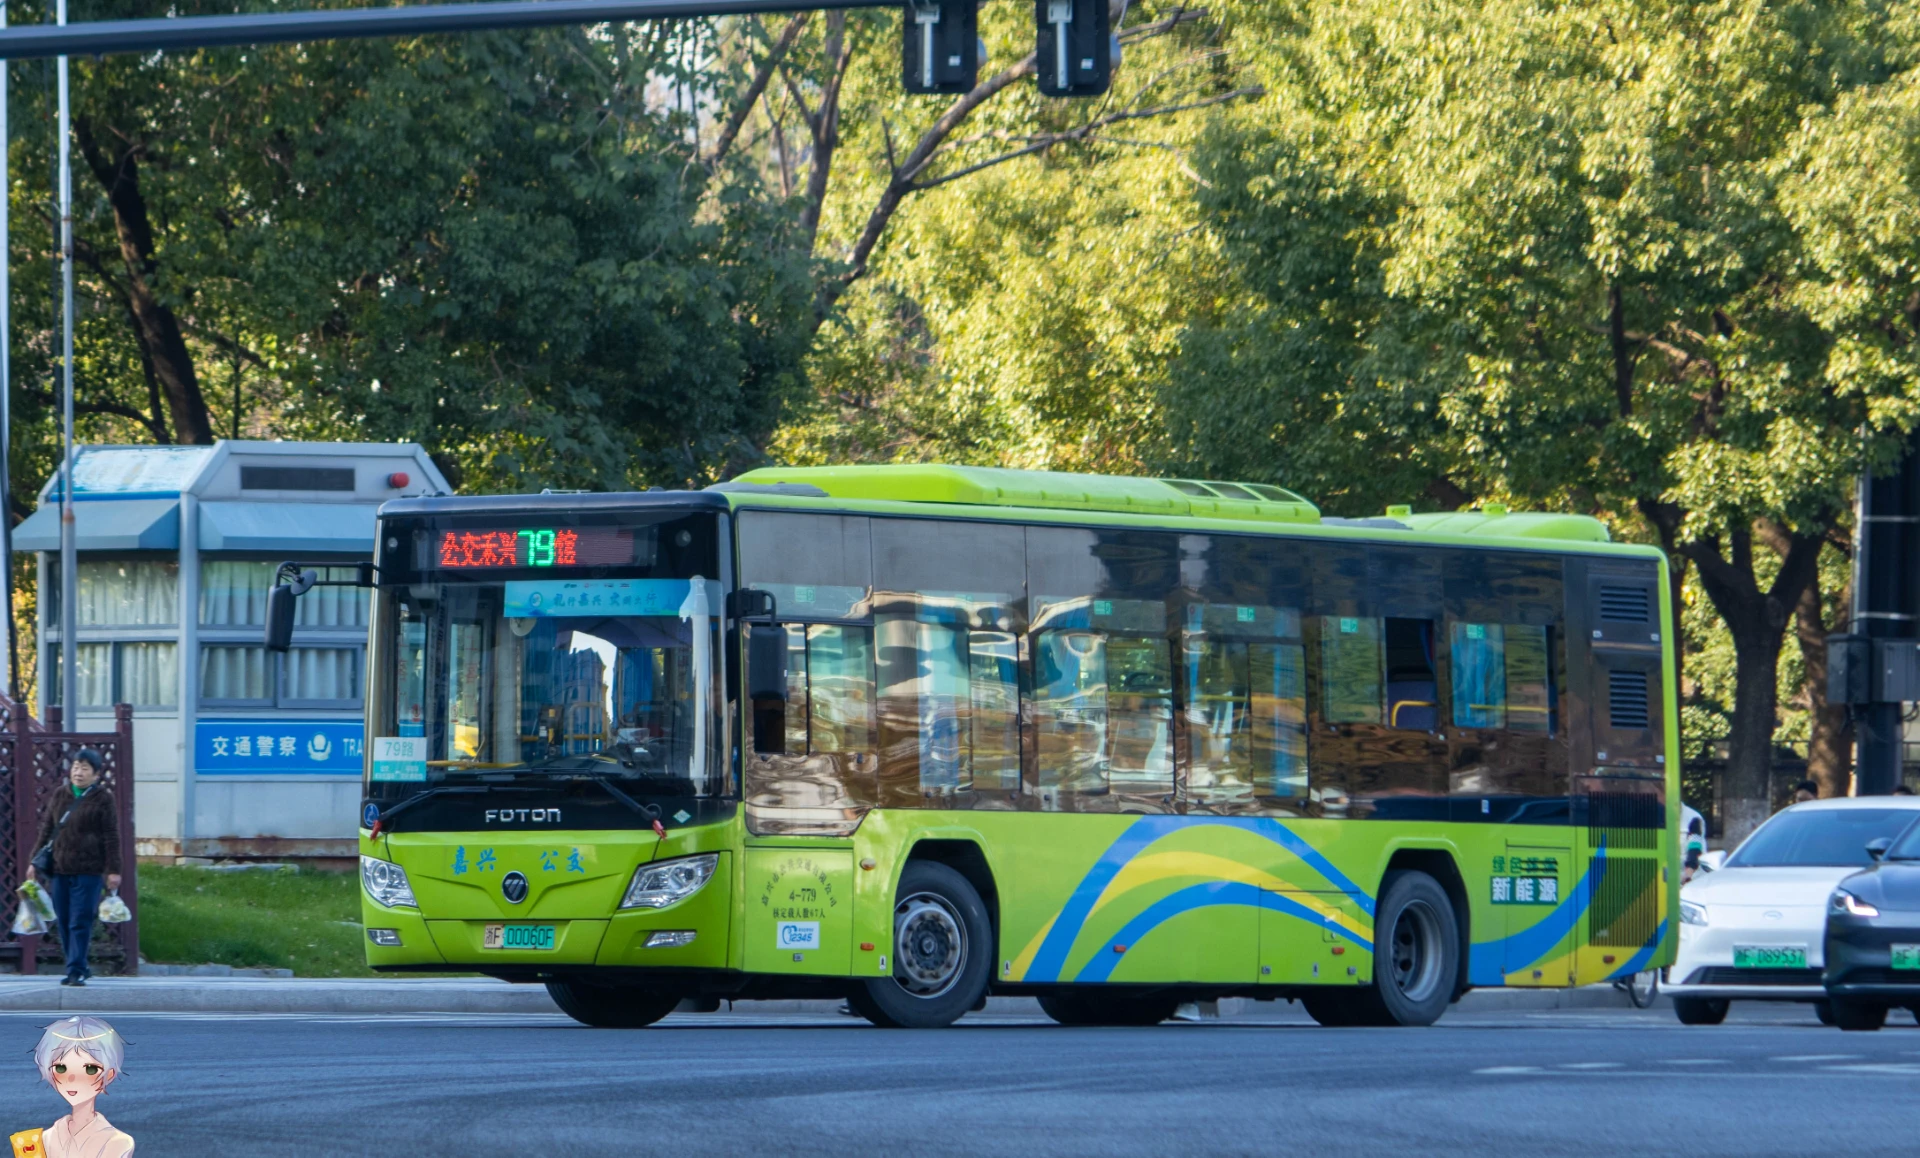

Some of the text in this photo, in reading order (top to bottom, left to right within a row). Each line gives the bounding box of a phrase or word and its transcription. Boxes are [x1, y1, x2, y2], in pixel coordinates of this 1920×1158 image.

[212, 735, 297, 757] 交通警察
[384, 741, 414, 757] 79路
[485, 808, 561, 823] FOTON
[450, 845, 585, 875] 嘉兴 公交
[789, 887, 817, 903] 4-779
[1491, 876, 1557, 902] 新能源
[789, 932, 813, 943] 12345
